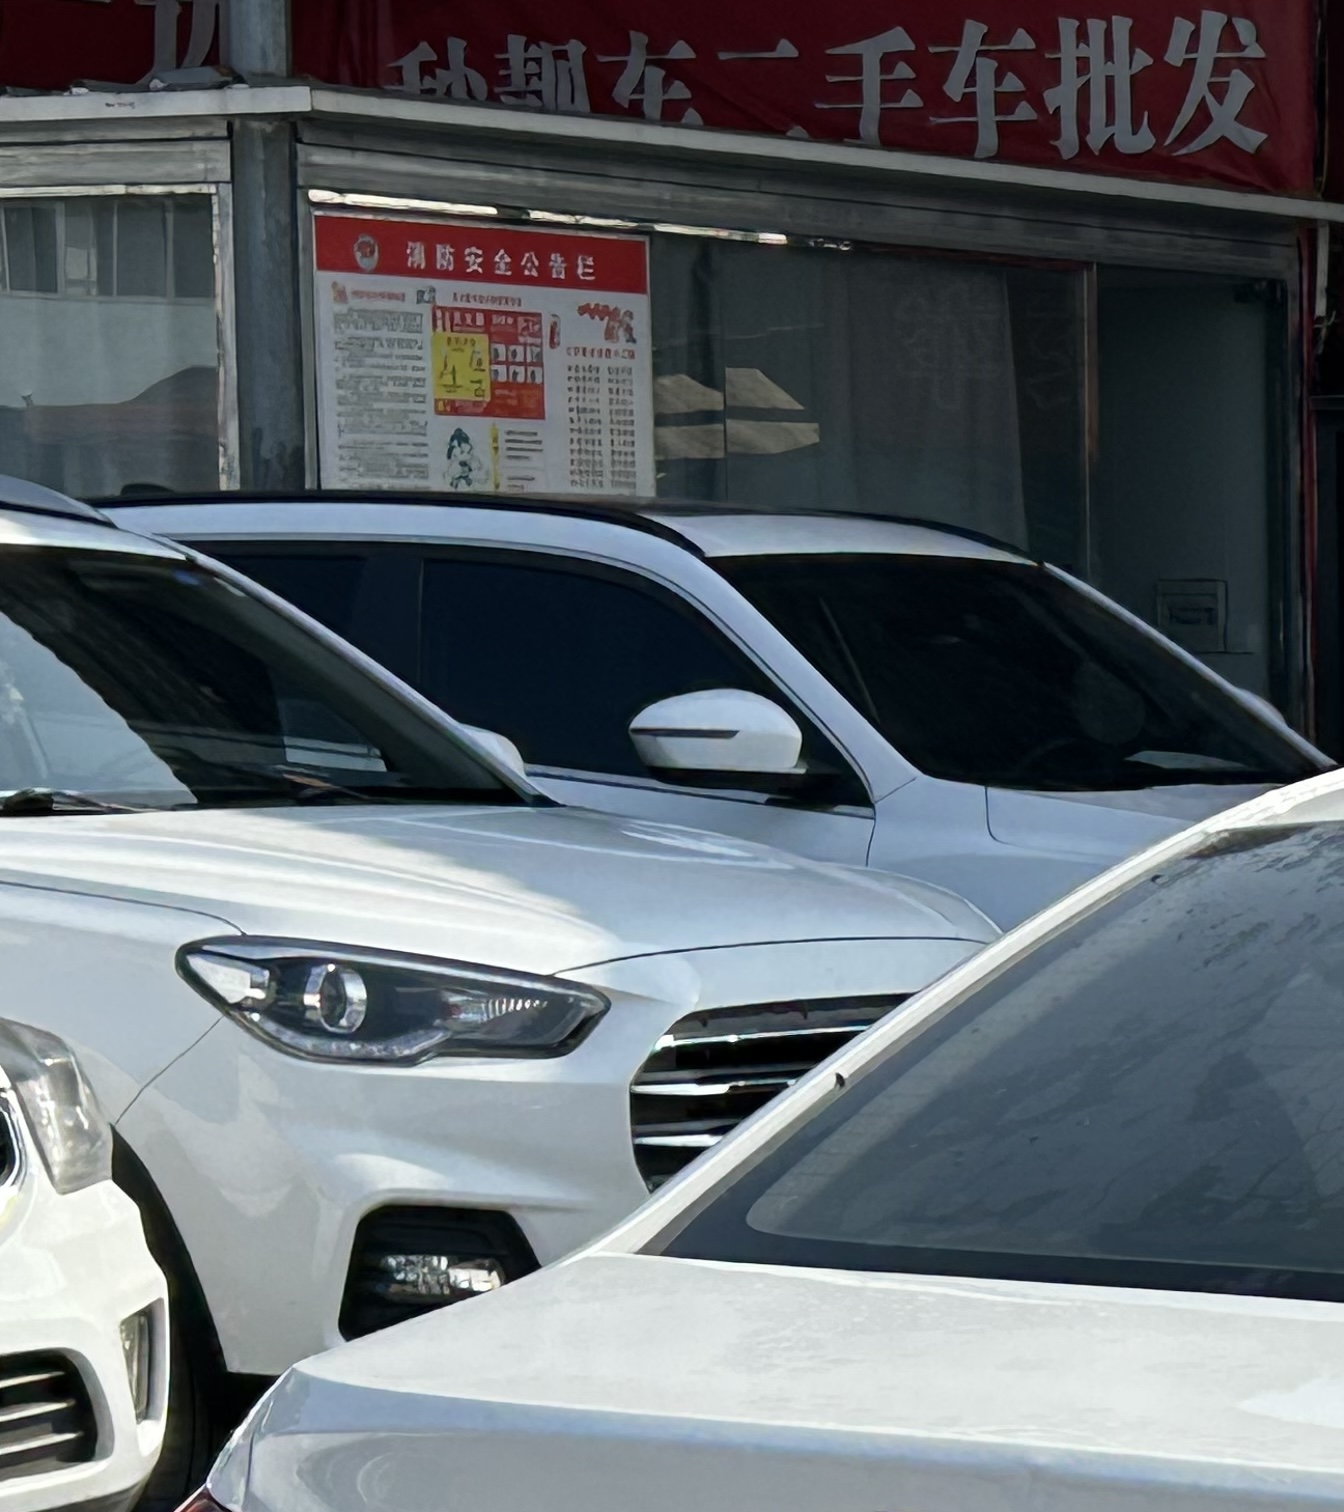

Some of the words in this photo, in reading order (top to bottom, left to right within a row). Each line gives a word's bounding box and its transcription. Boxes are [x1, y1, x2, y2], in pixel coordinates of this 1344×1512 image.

[406, 240, 597, 281] 消防安全公告栏
